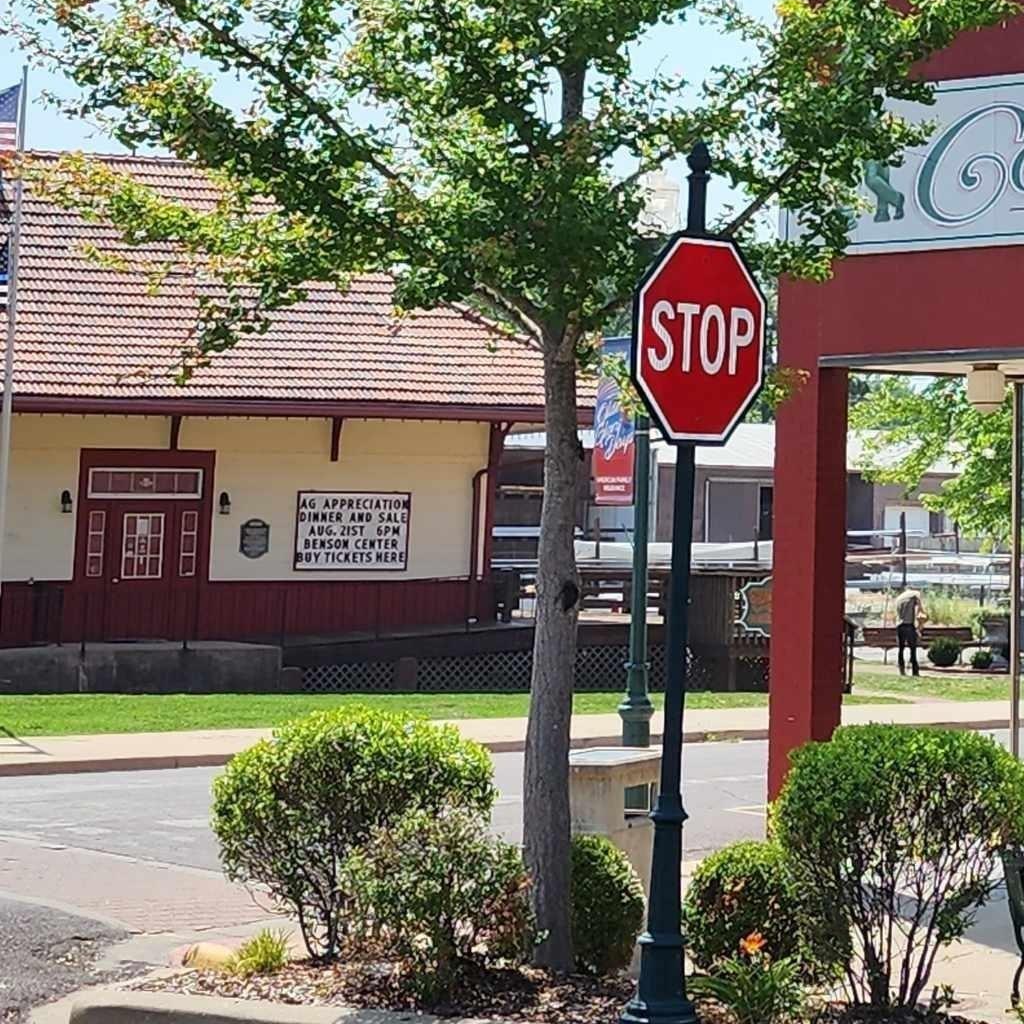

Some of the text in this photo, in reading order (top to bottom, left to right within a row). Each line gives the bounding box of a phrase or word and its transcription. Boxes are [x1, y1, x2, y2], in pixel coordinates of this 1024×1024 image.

[647, 299, 755, 375] STOP
[300, 499, 409, 510] AG APPRECIATION
[300, 512, 407, 523] DINNER AND SALE
[308, 525, 400, 536] AUG. 21ST 6PM
[303, 539, 398, 549] BENSON CENTER
[296, 552, 405, 563] BUY TICKETS HERE
